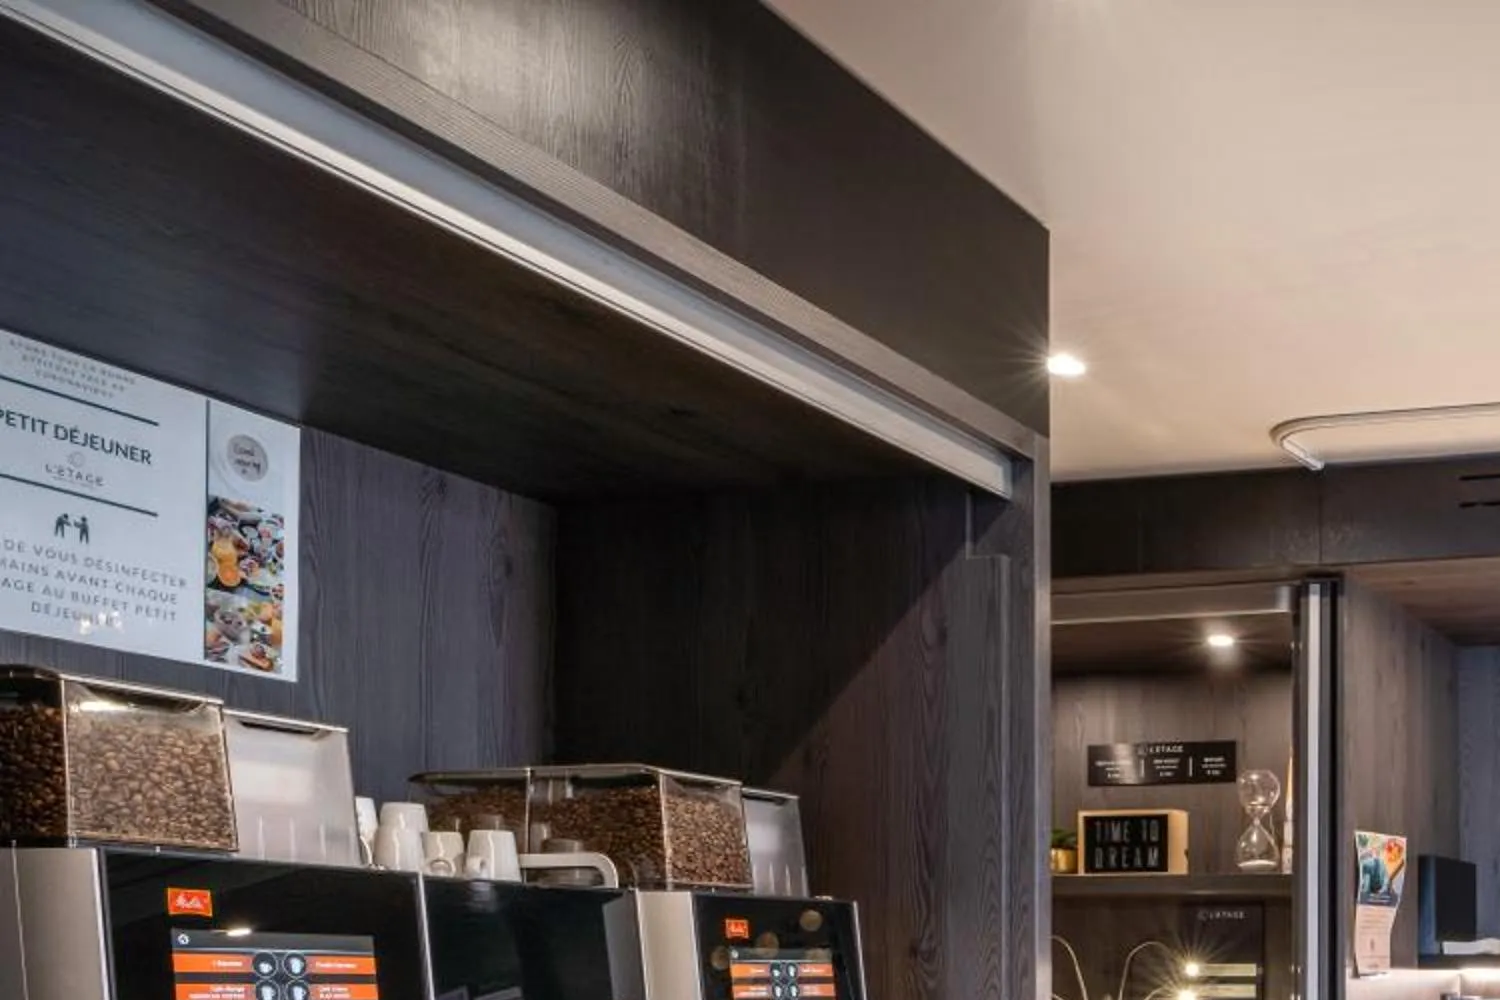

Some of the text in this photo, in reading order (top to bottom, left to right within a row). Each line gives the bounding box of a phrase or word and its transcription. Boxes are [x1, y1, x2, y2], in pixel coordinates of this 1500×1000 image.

[53, 424, 152, 465] DÉJEUNER
[4, 539, 26, 553] DE
[33, 545, 78, 566] VOUS
[54, 569, 108, 588] AVANT
[114, 582, 178, 605] CHAQUE
[42, 584, 65, 600] AU
[71, 591, 129, 612] BUFFET
[135, 604, 177, 622] PETIT
[1094, 819, 1159, 843] TIME TO
[1094, 846, 1159, 869] DREAM
